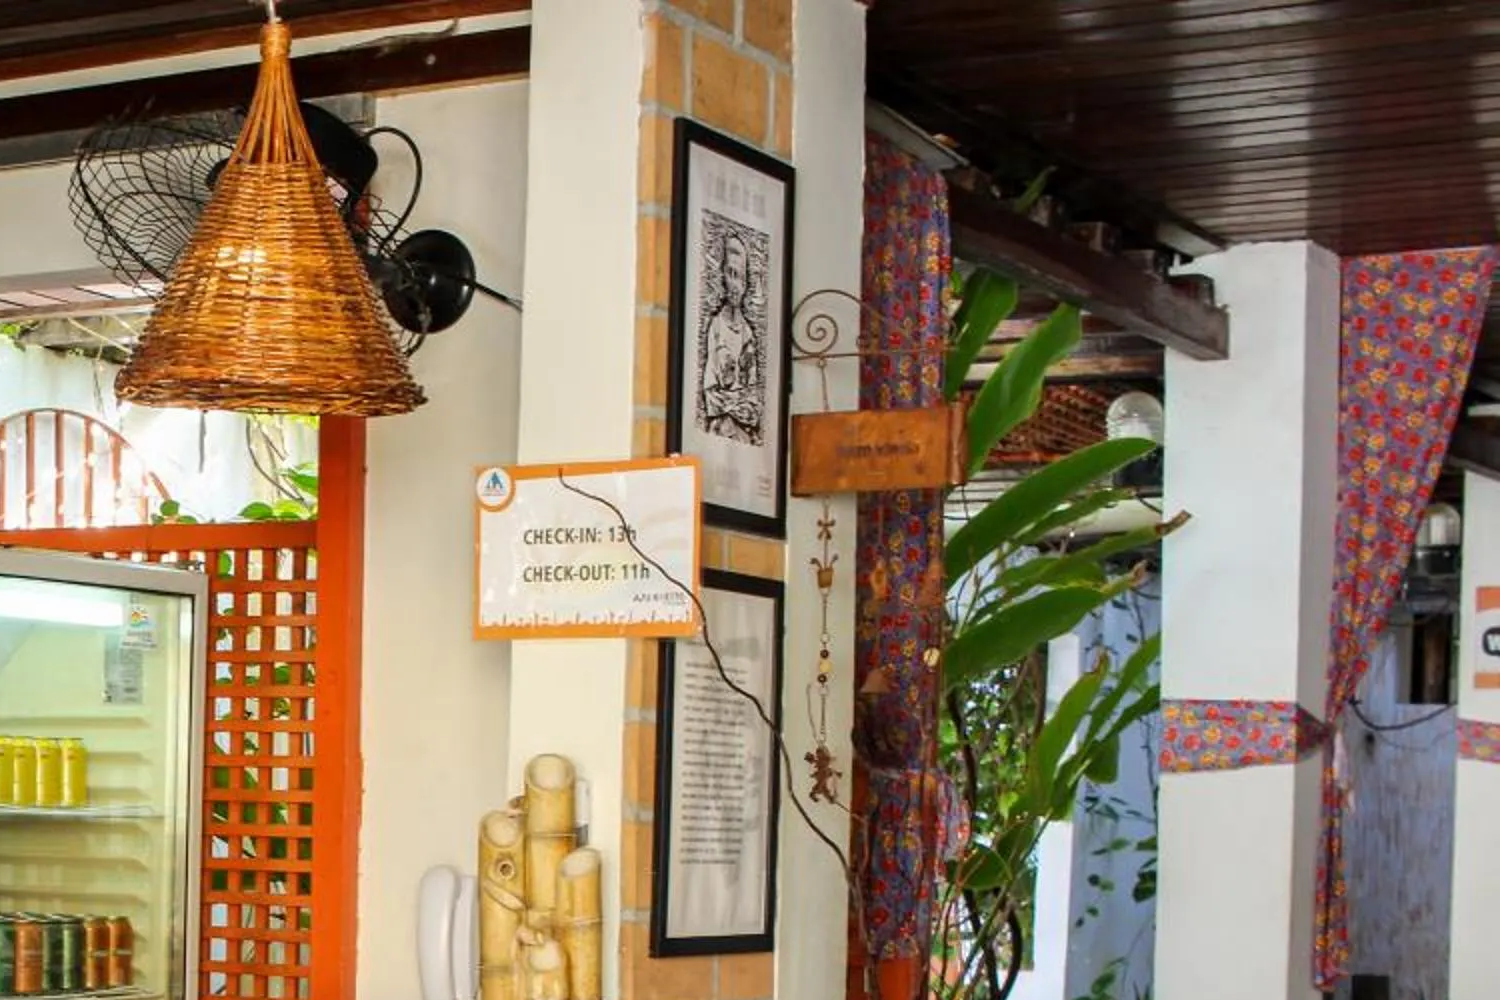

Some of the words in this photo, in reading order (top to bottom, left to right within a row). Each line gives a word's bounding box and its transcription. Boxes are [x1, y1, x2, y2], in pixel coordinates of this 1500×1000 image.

[523, 527, 602, 546] CHECK-IN:
[608, 525, 637, 543] 13h
[523, 564, 615, 583] CHECK-OUT:
[621, 562, 651, 582] 11h
